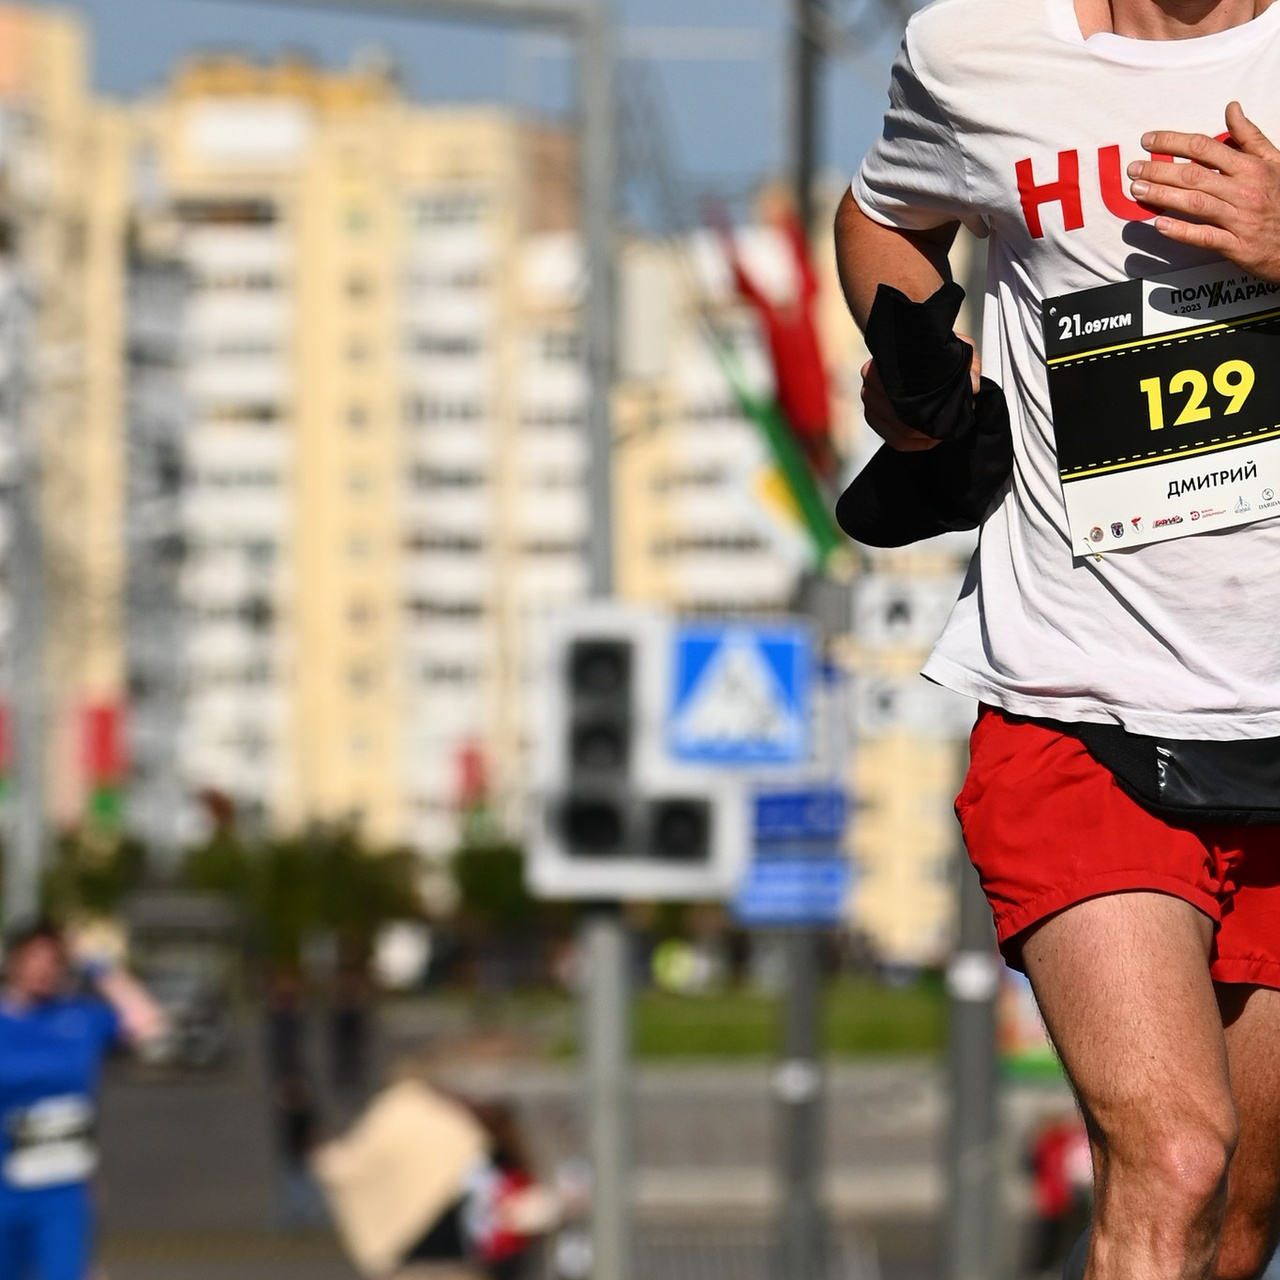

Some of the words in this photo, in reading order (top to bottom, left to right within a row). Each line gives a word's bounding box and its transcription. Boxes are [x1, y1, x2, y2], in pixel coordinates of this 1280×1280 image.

[1180, 303, 1202, 314] 2023
[1140, 359, 1255, 431] 129
[1167, 461, 1257, 499] ДМИТРИЙ
